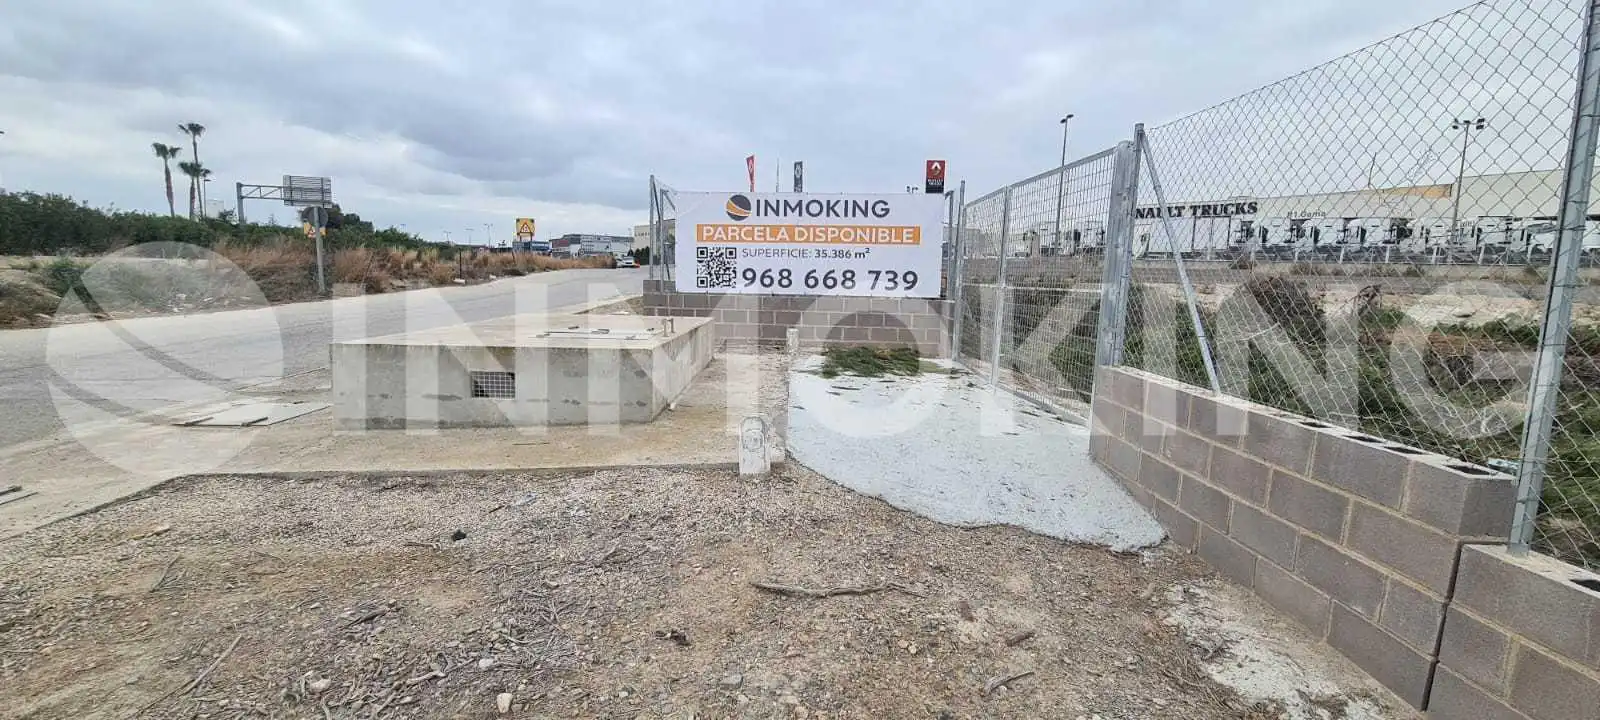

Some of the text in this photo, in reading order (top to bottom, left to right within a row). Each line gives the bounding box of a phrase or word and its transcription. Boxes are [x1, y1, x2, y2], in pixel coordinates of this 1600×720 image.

[756, 199, 890, 218] INMOKING
[1190, 202, 1258, 216] TRUCKS
[702, 226, 914, 243] PARCELA DISPONIBLE
[742, 248, 811, 258] SUPERFICIE:
[814, 249, 851, 259] 35.386
[742, 268, 918, 290] 968 668 739
